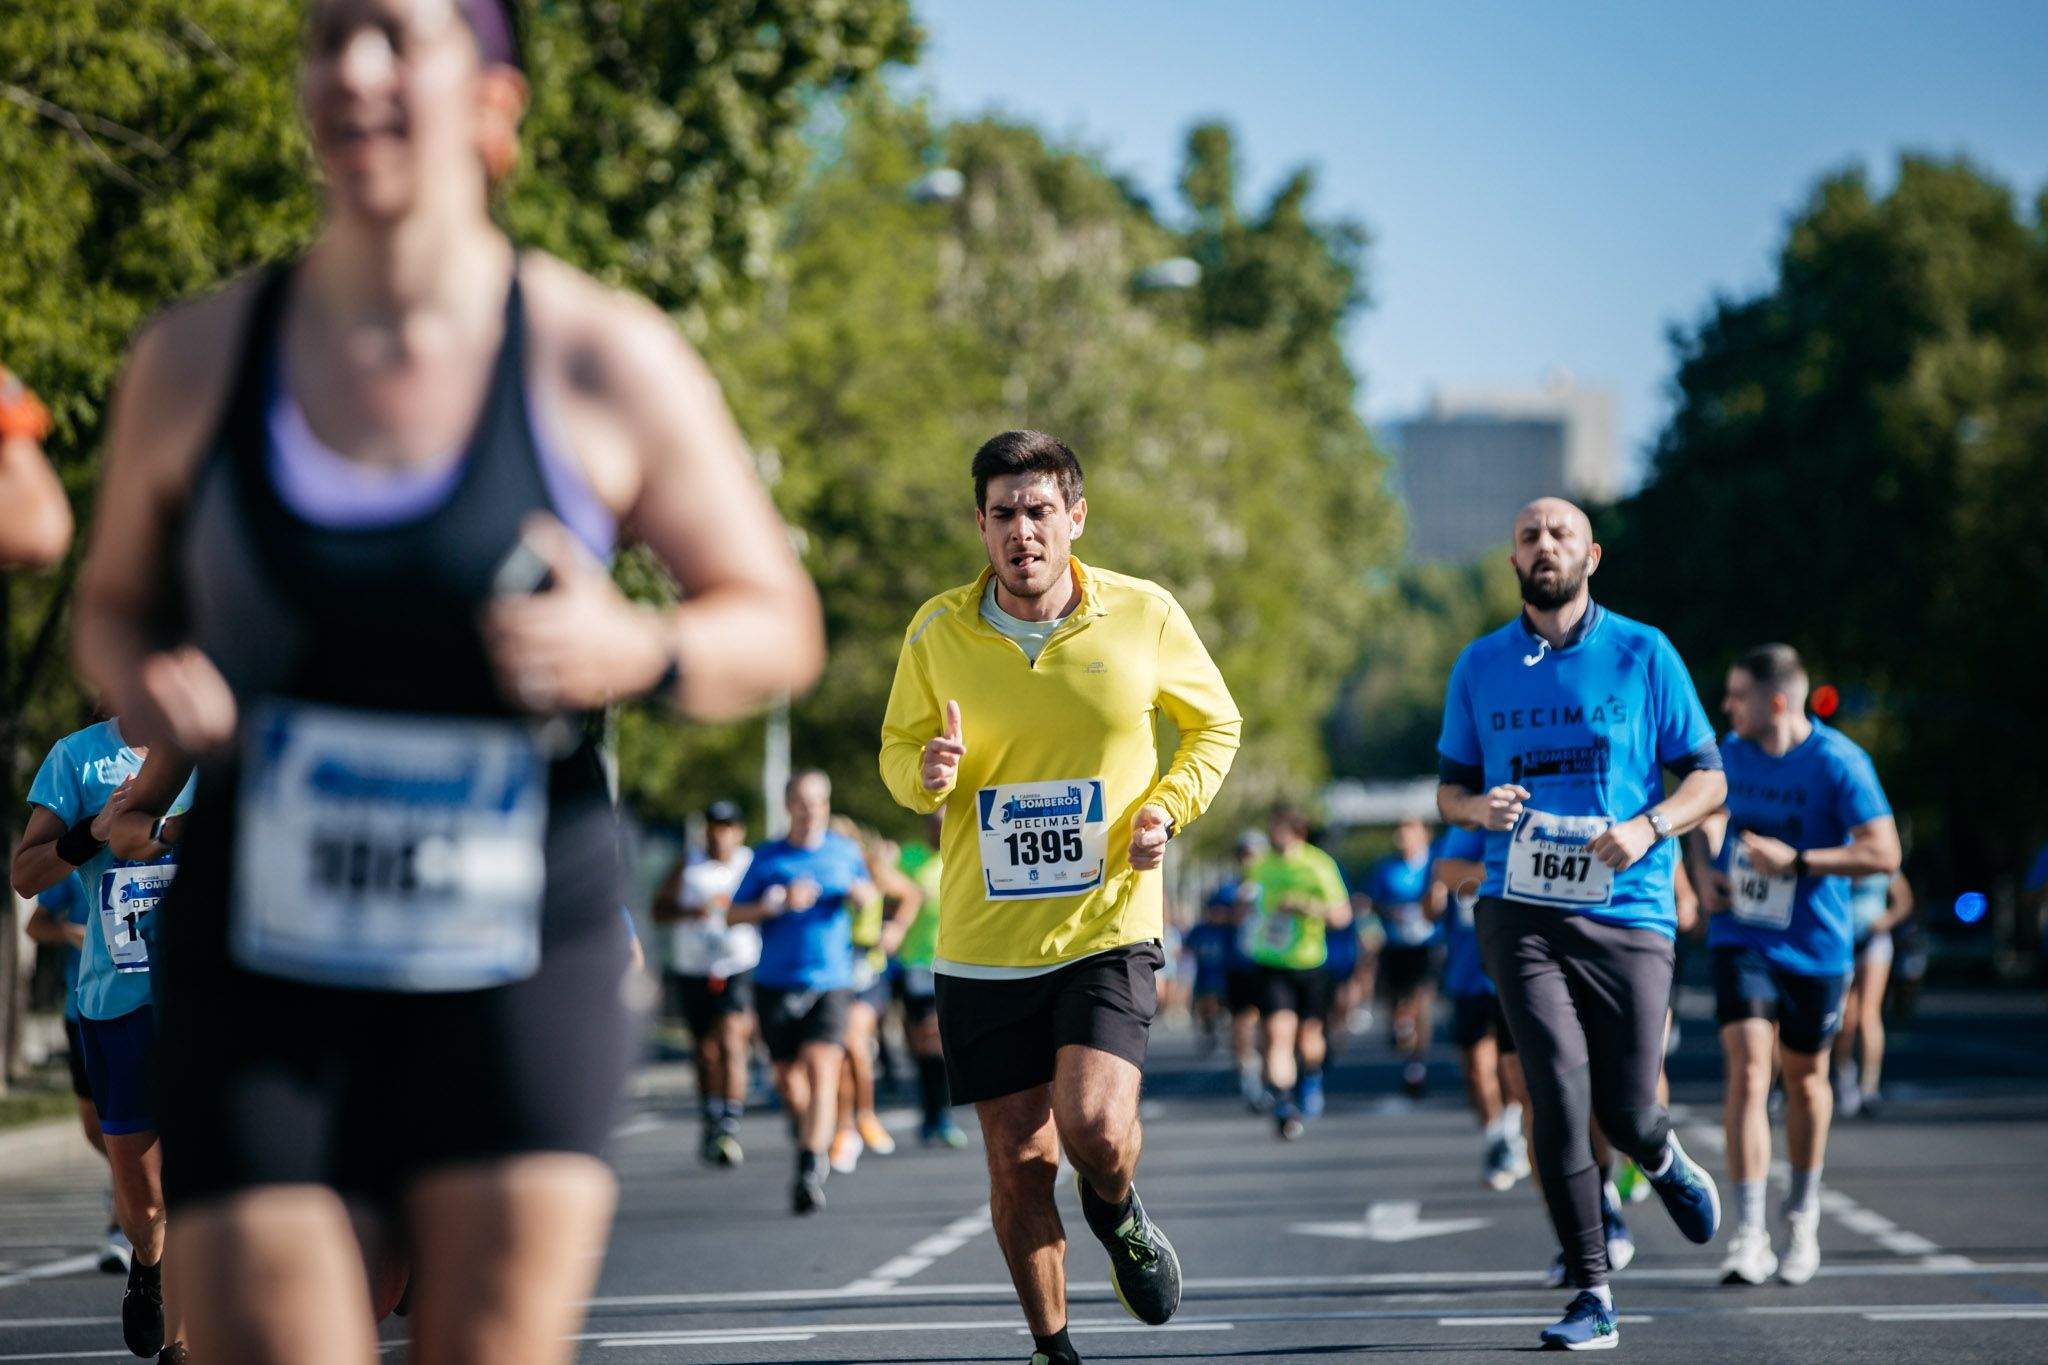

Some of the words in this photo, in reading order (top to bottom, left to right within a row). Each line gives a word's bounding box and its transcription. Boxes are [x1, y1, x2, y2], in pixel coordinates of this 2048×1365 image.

[1491, 703, 1627, 731] DECIMAS
[1019, 796, 1080, 809] BOMBEROS
[1015, 815, 1080, 829] DECIMAS
[1004, 829, 1083, 866] 1395
[1531, 852, 1592, 883] 1647
